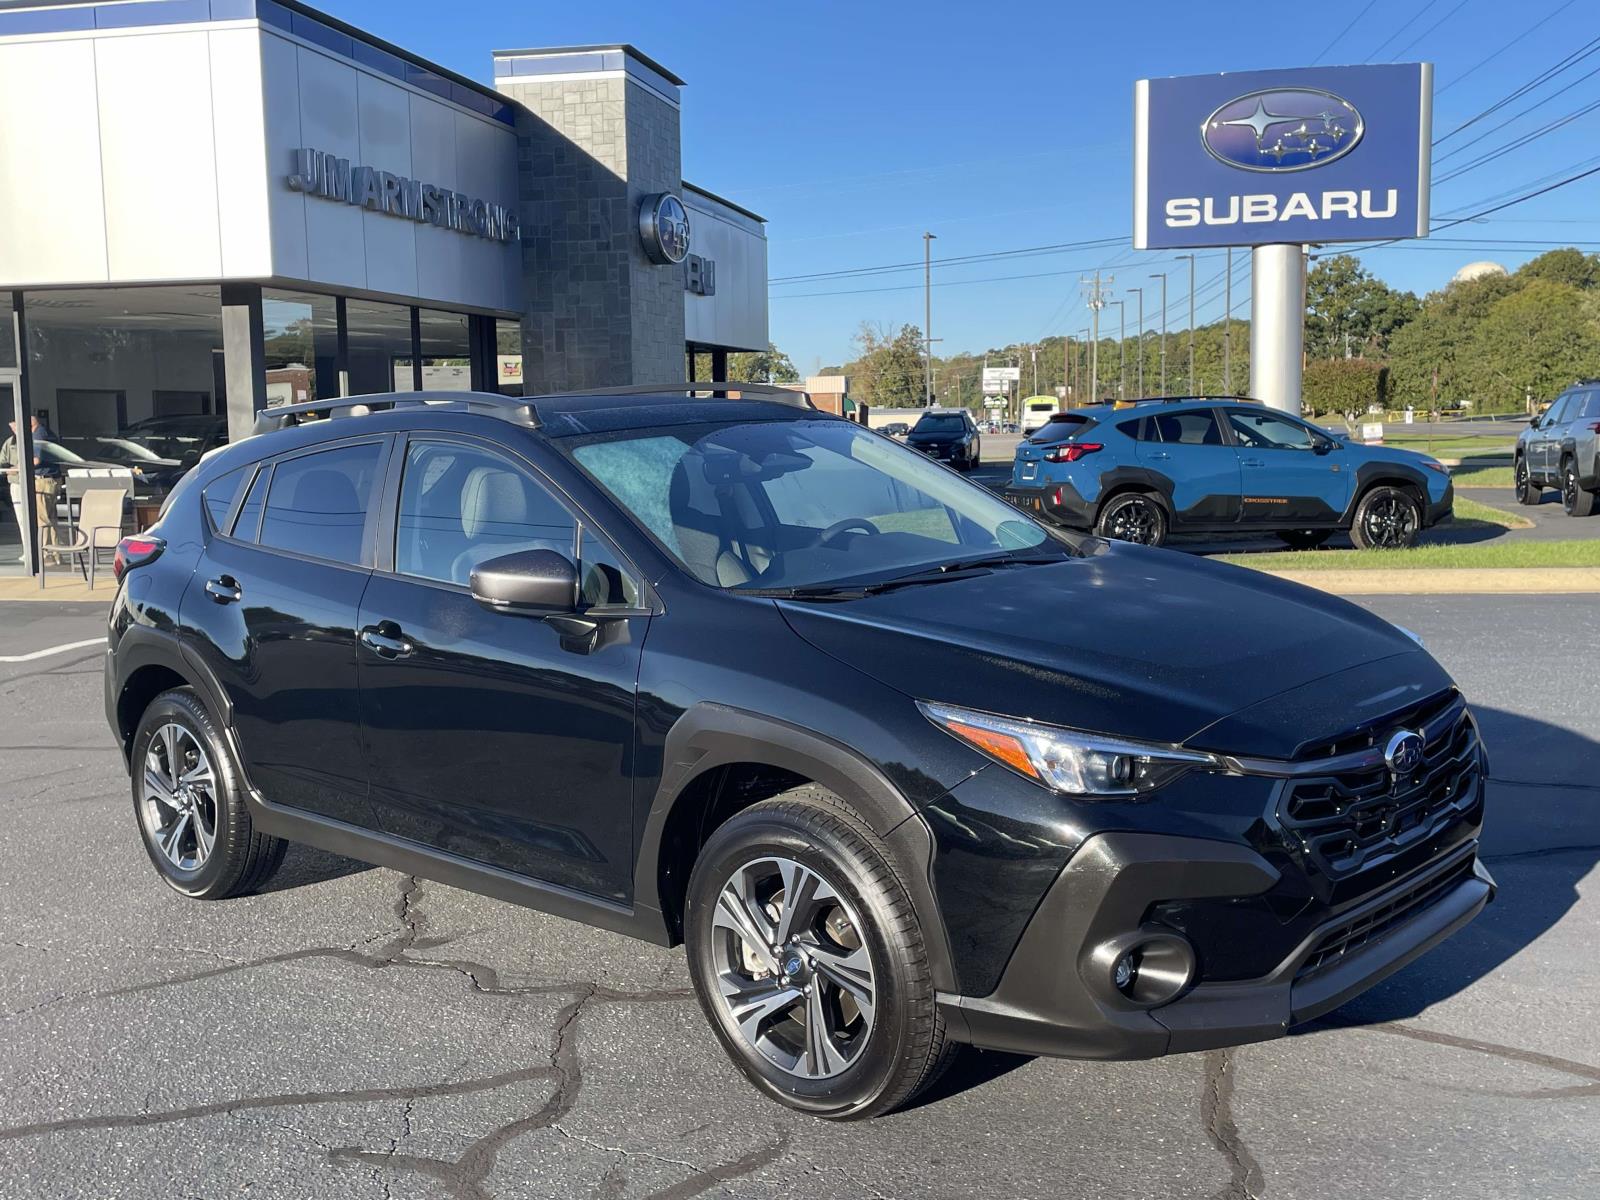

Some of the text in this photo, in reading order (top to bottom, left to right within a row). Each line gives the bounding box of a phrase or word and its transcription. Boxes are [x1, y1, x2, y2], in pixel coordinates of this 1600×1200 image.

[288, 148, 521, 241] JIM ARMSTRONG
[1166, 189, 1398, 227] SUBARU
